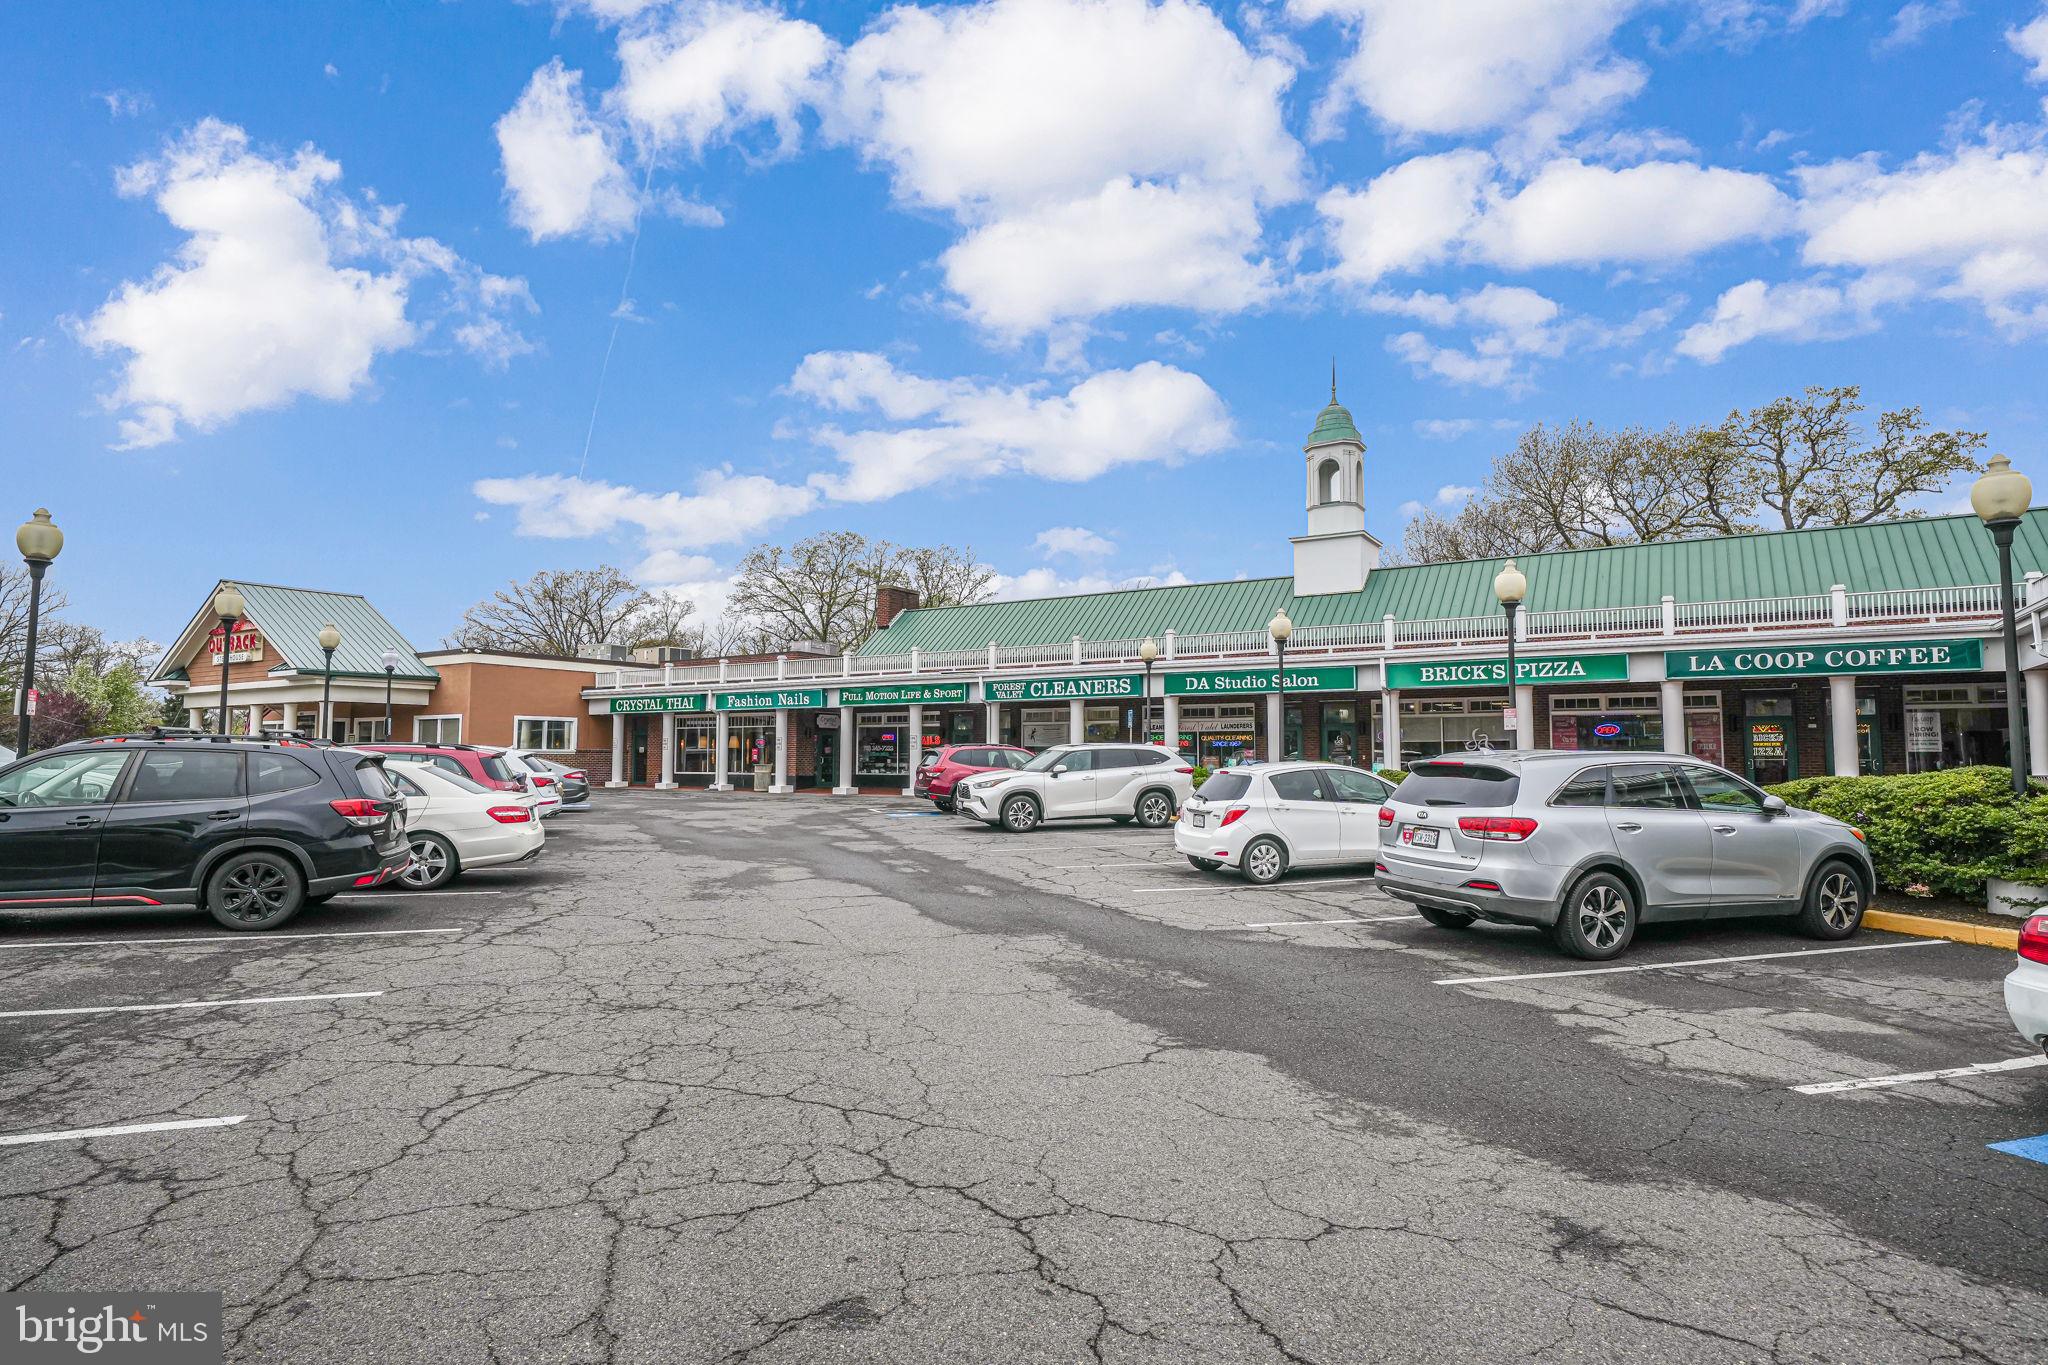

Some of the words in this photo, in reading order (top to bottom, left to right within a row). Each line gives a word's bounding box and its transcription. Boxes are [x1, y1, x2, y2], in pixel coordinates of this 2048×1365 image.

[208, 633, 256, 653] OUBACK
[1688, 655, 1725, 672] LA
[1734, 652, 1814, 670] COOP
[1824, 646, 1950, 667] COFFEE
[1420, 664, 1506, 682] BRICK'S
[1515, 661, 1586, 678] PIZZA
[992, 682, 1026, 691] FOREST
[1030, 678, 1131, 697] CLEANERS
[1185, 677, 1210, 690] DA
[1214, 675, 1267, 689] Studio
[1271, 674, 1319, 687] Salon
[727, 695, 773, 708] Fashion
[777, 693, 810, 706] Nails
[842, 692, 863, 701] FULL
[865, 691, 898, 701] MOTION
[900, 690, 920, 699] LIFE
[923, 689, 932, 698] &
[933, 688, 962, 698] SPORT
[995, 690, 1024, 699] VALET
[616, 698, 663, 711] CRYSTAL
[666, 696, 695, 710] THAI
[1753, 746, 1784, 756] IZZA
